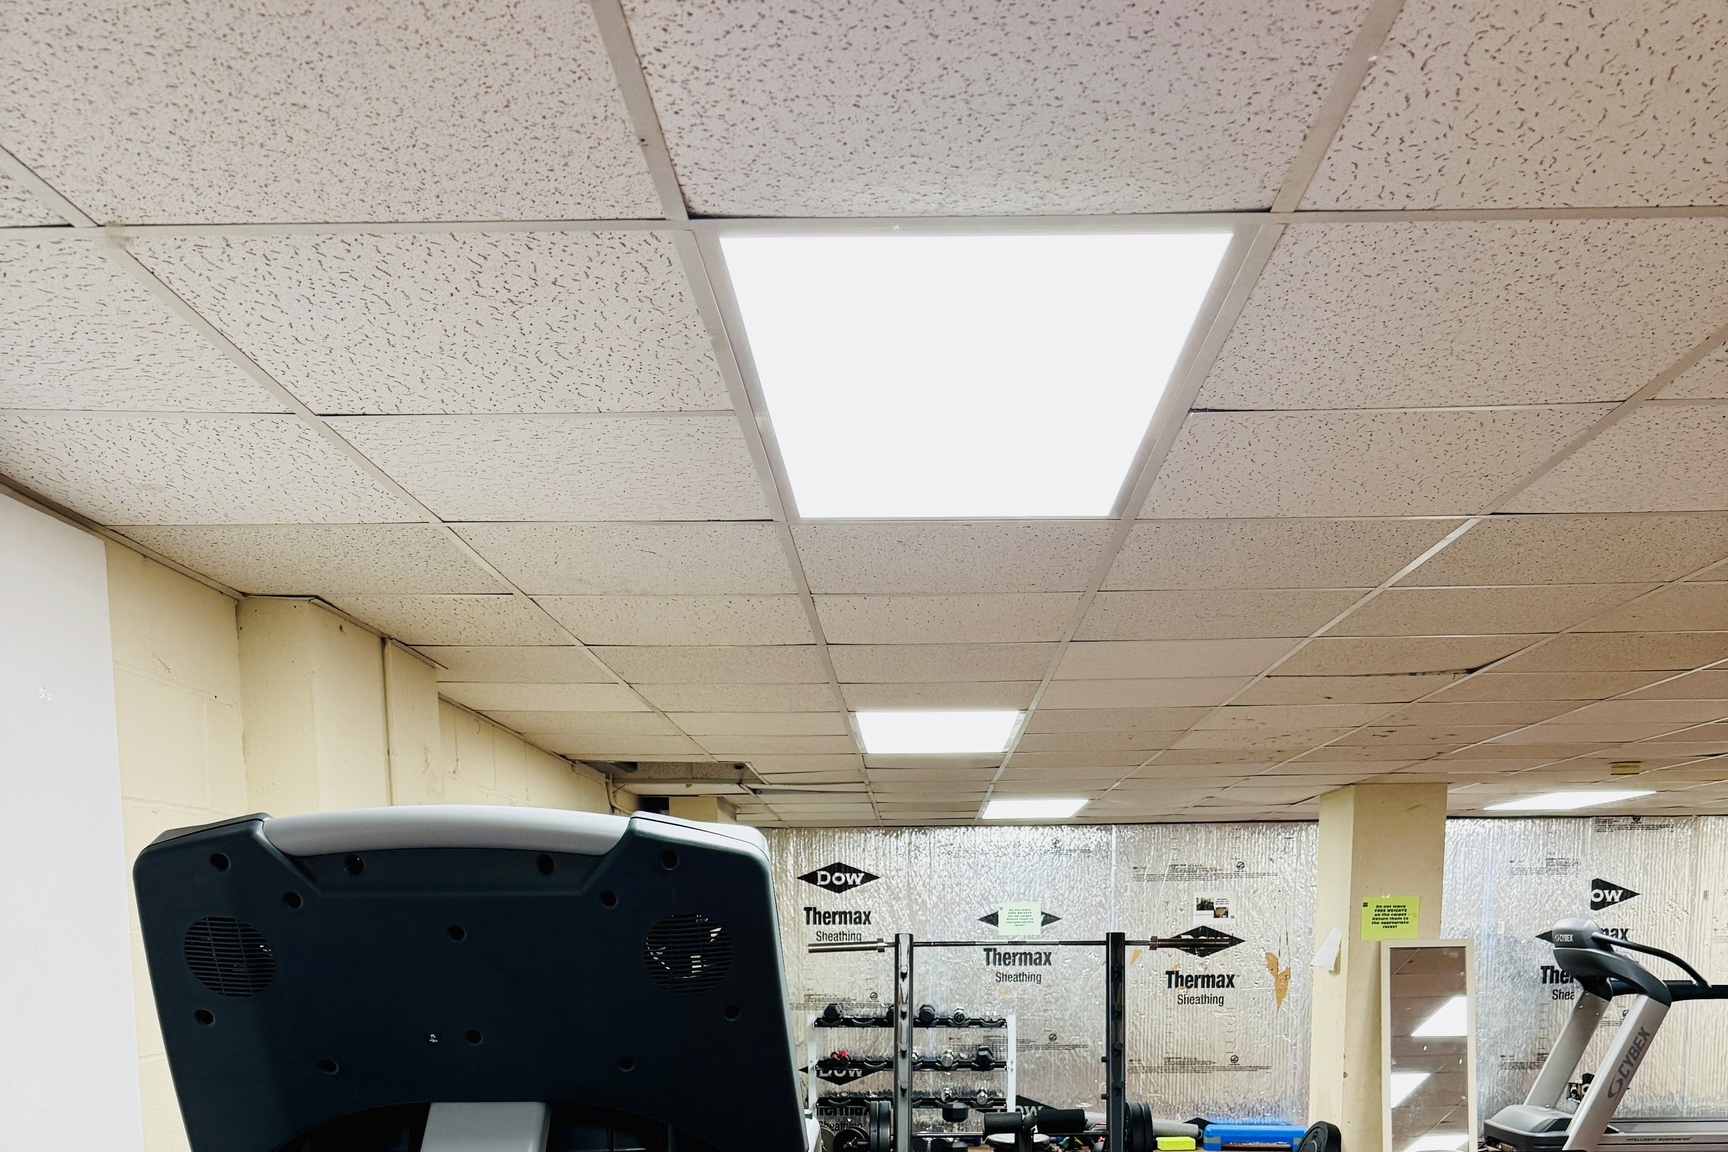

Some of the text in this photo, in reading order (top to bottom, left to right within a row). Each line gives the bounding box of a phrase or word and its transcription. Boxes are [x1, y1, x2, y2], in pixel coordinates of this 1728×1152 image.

[816, 871, 865, 886] DOW
[1589, 888, 1624, 903] OW
[803, 907, 872, 925] Thermax
[815, 930, 862, 942] Sheathing
[983, 947, 1053, 967] Thermax
[995, 971, 1042, 984] Sheathing
[1165, 970, 1236, 989] Thermax
[1177, 993, 1225, 1007] Sheathing
[1617, 1026, 1651, 1080] CYBEX
